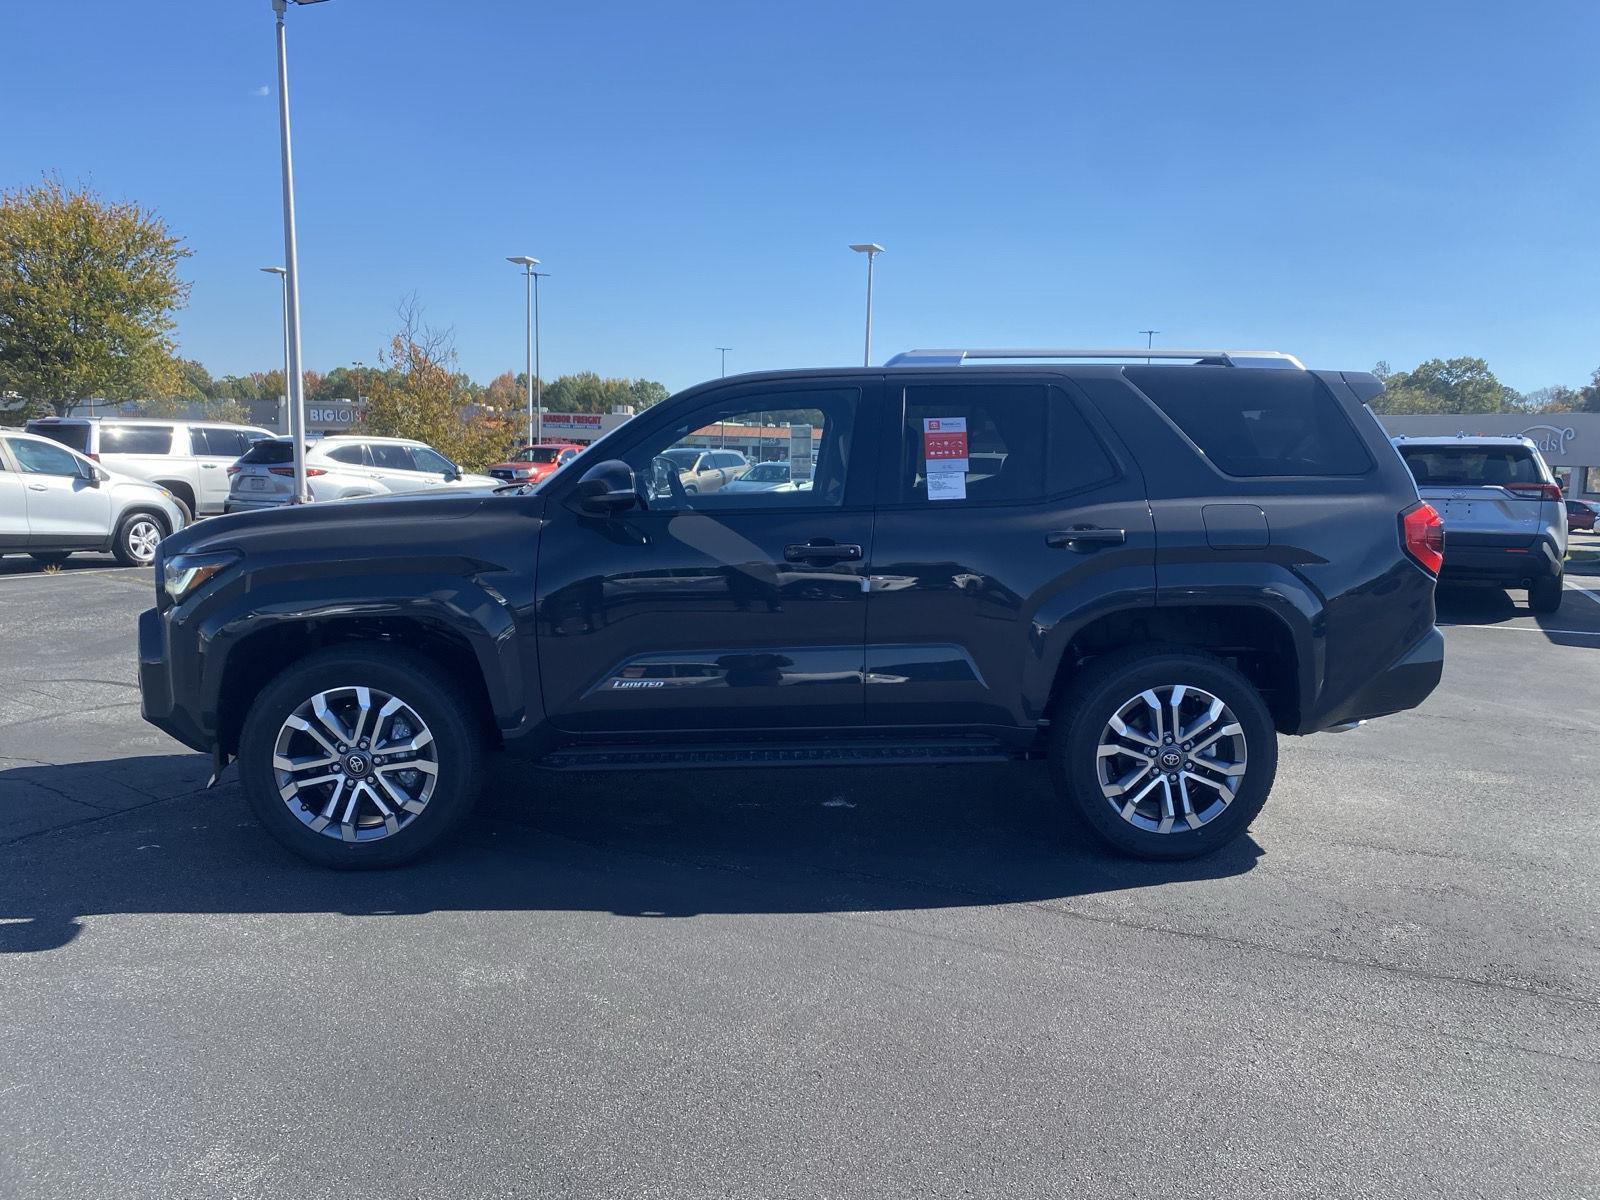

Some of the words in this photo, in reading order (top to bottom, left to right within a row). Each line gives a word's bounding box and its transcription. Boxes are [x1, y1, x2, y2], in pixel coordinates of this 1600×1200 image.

[543, 414, 570, 423] HARBOR
[573, 415, 602, 425] FREIGHT
[612, 680, 664, 689] LIMITED
